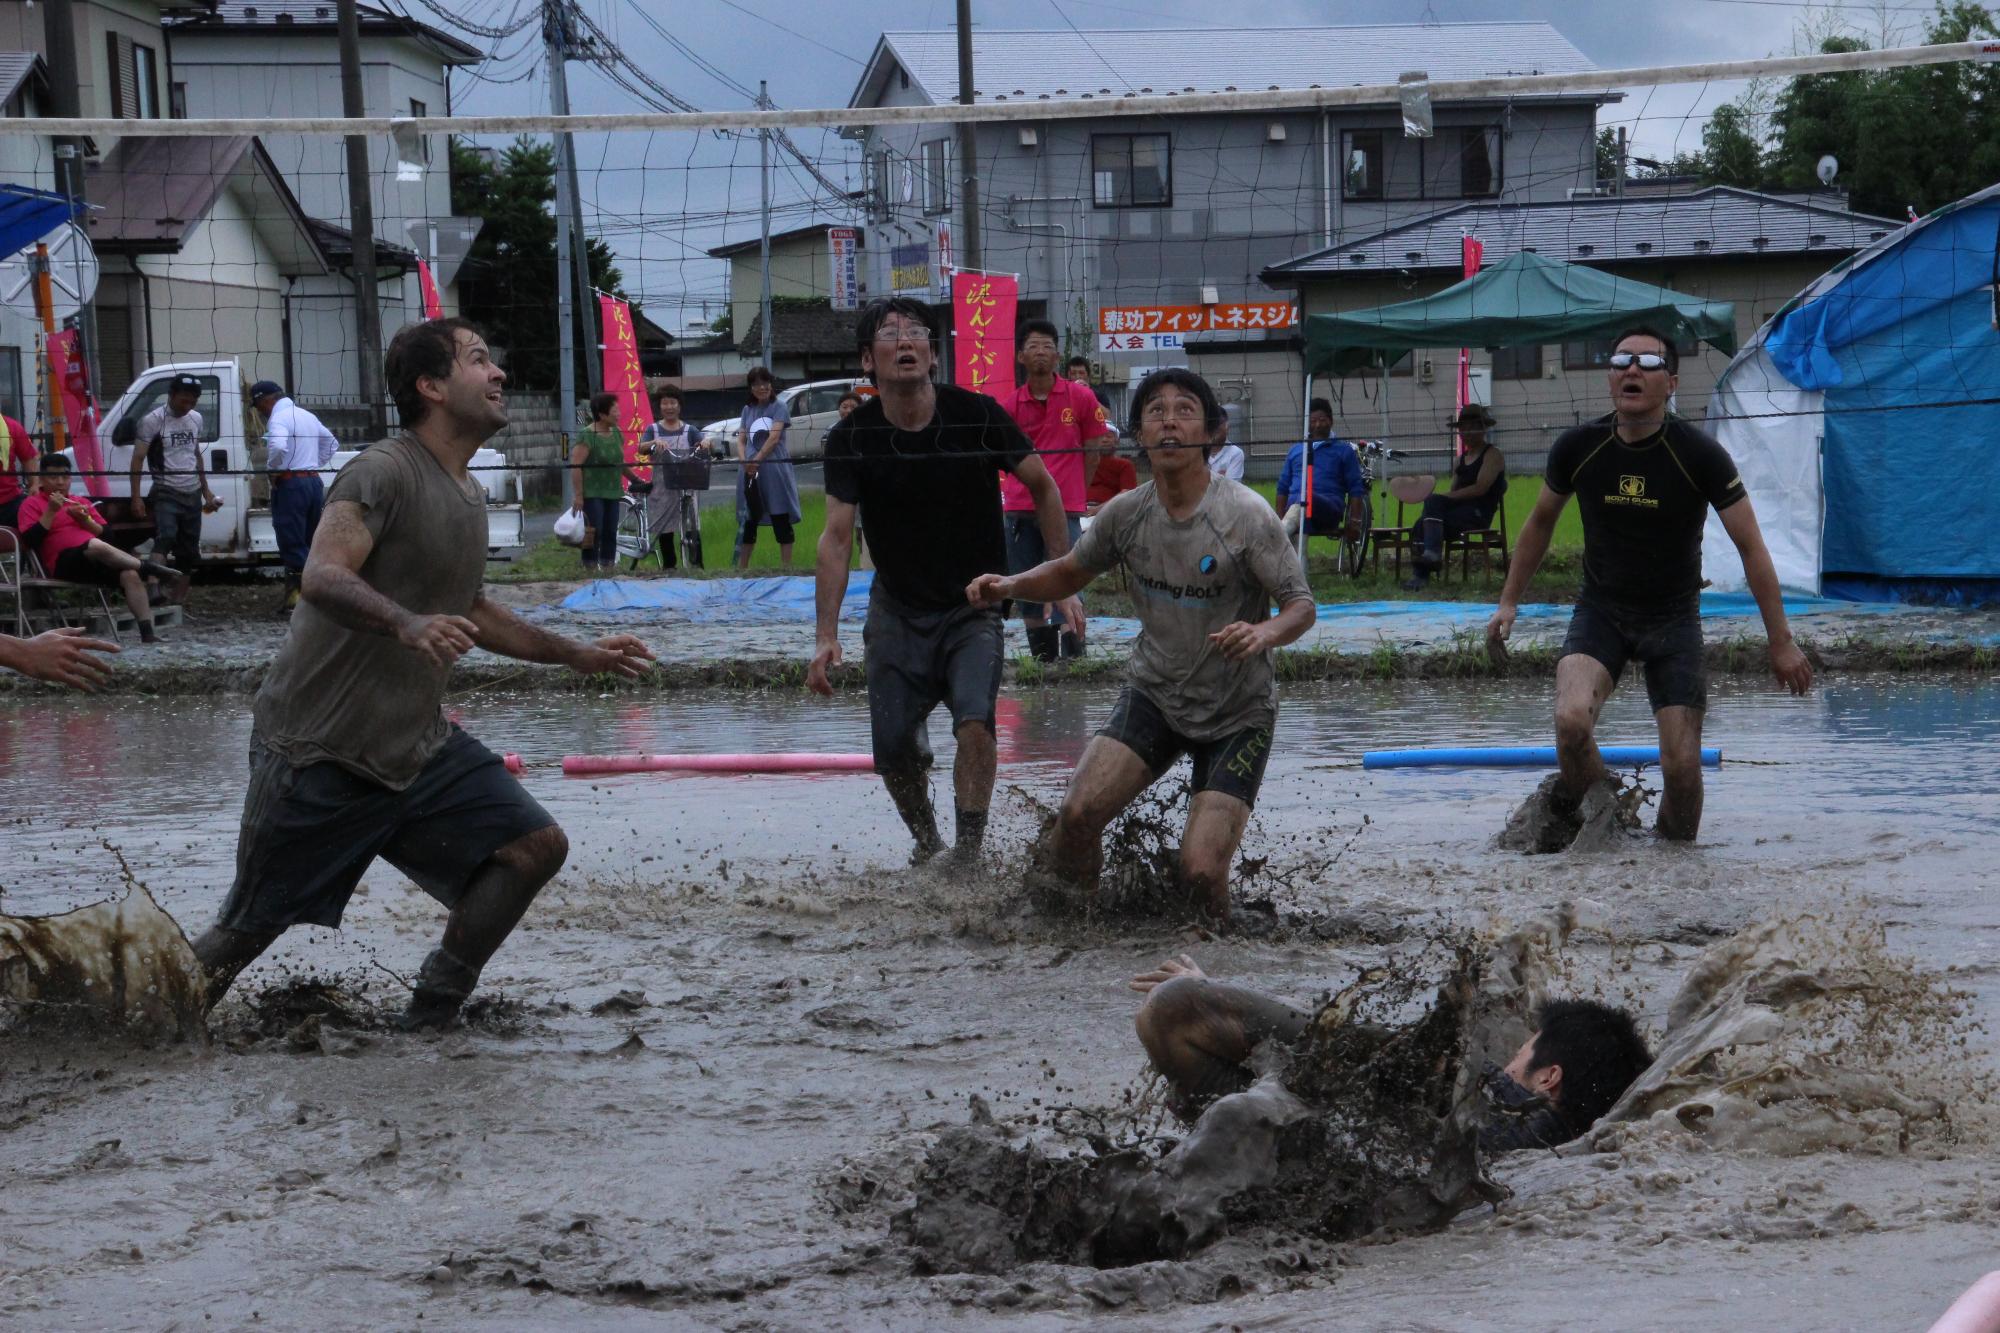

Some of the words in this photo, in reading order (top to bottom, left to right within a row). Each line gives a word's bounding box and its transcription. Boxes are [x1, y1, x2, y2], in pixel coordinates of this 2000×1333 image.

[833, 230, 854, 238] YOGA
[966, 283, 997, 394] 泥んこバレ
[1632, 497, 1658, 505] GLOVE
[1185, 584, 1226, 599] BOLT
